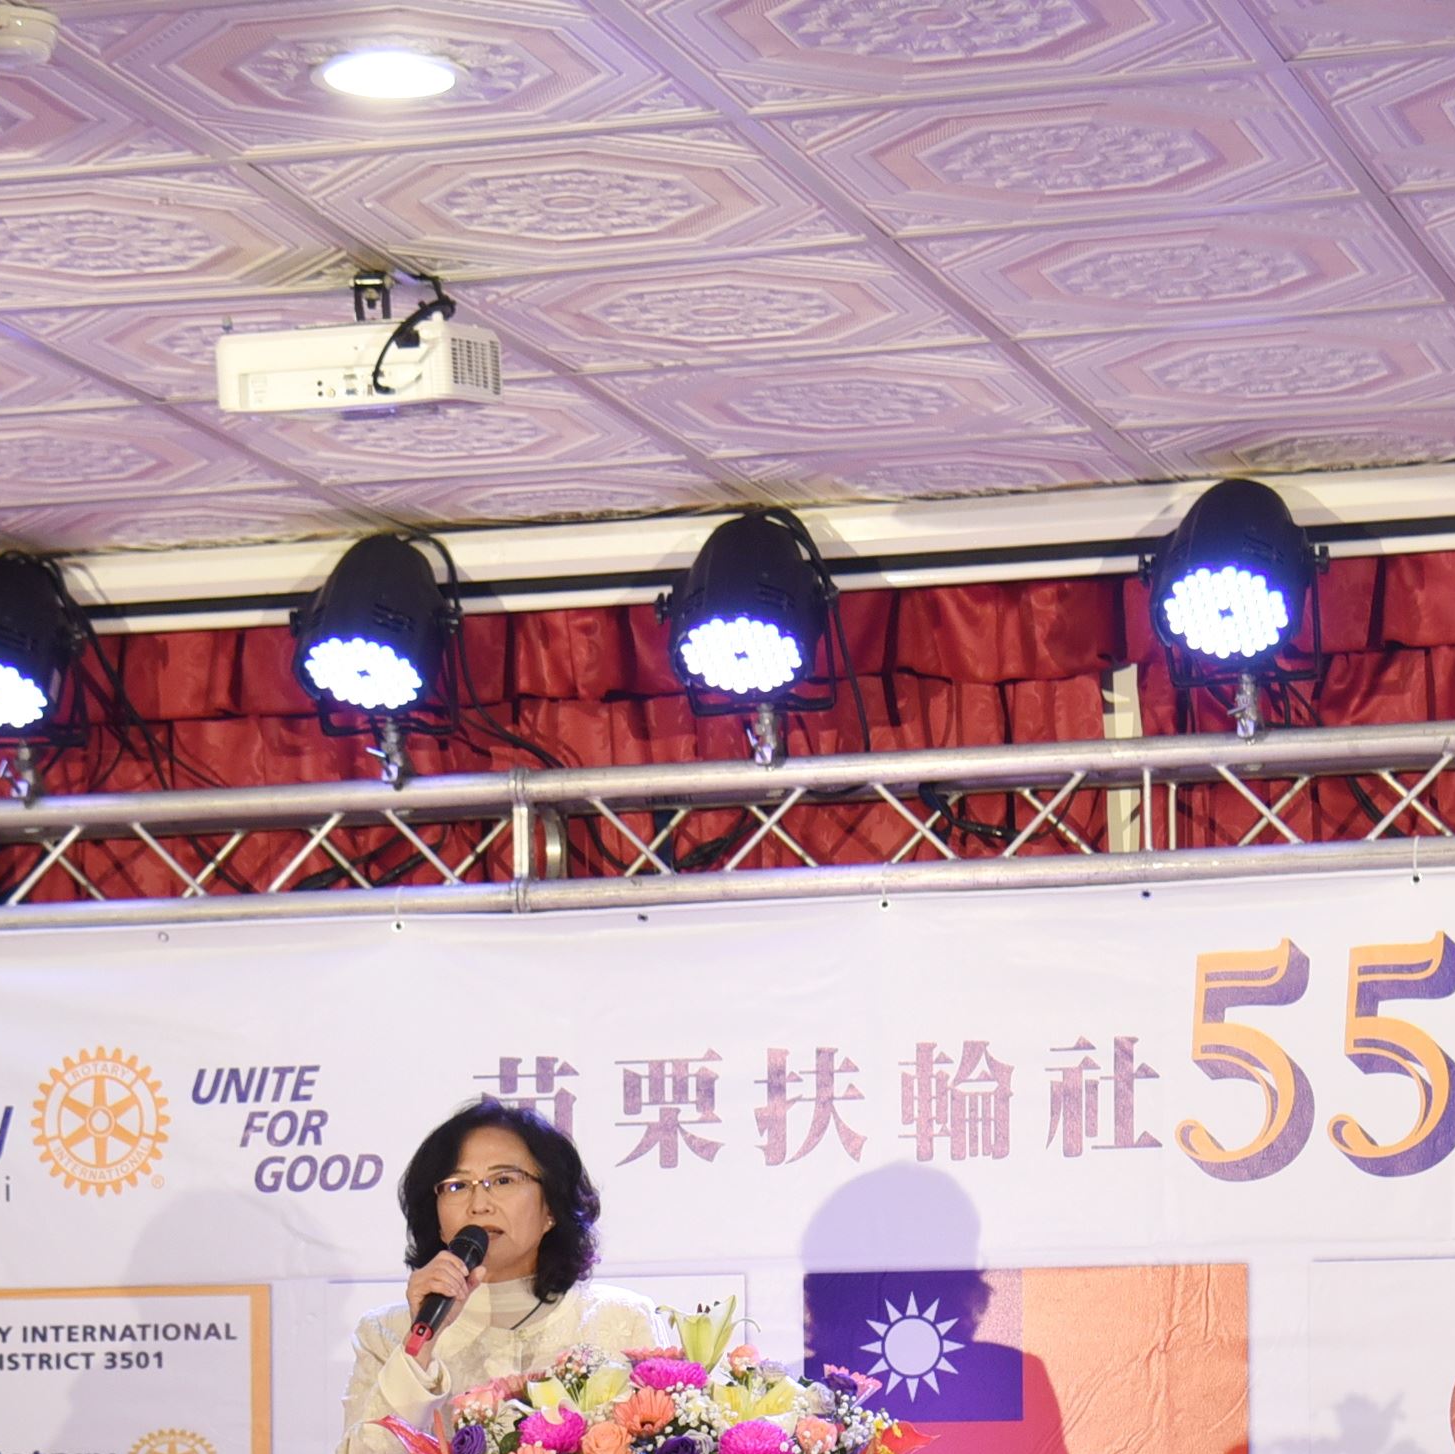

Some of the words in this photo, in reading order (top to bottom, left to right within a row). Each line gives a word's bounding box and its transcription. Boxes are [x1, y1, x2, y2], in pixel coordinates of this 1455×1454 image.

[70, 1062, 130, 1081] ROTARY
[191, 1065, 321, 1106] UNITE
[240, 1110, 329, 1148] FOR
[54, 1142, 151, 1181] INTERNATIONAL
[254, 1154, 384, 1193] GOOD
[22, 1321, 238, 1344] INTERNATIONAL
[103, 1350, 165, 1371] 3501
